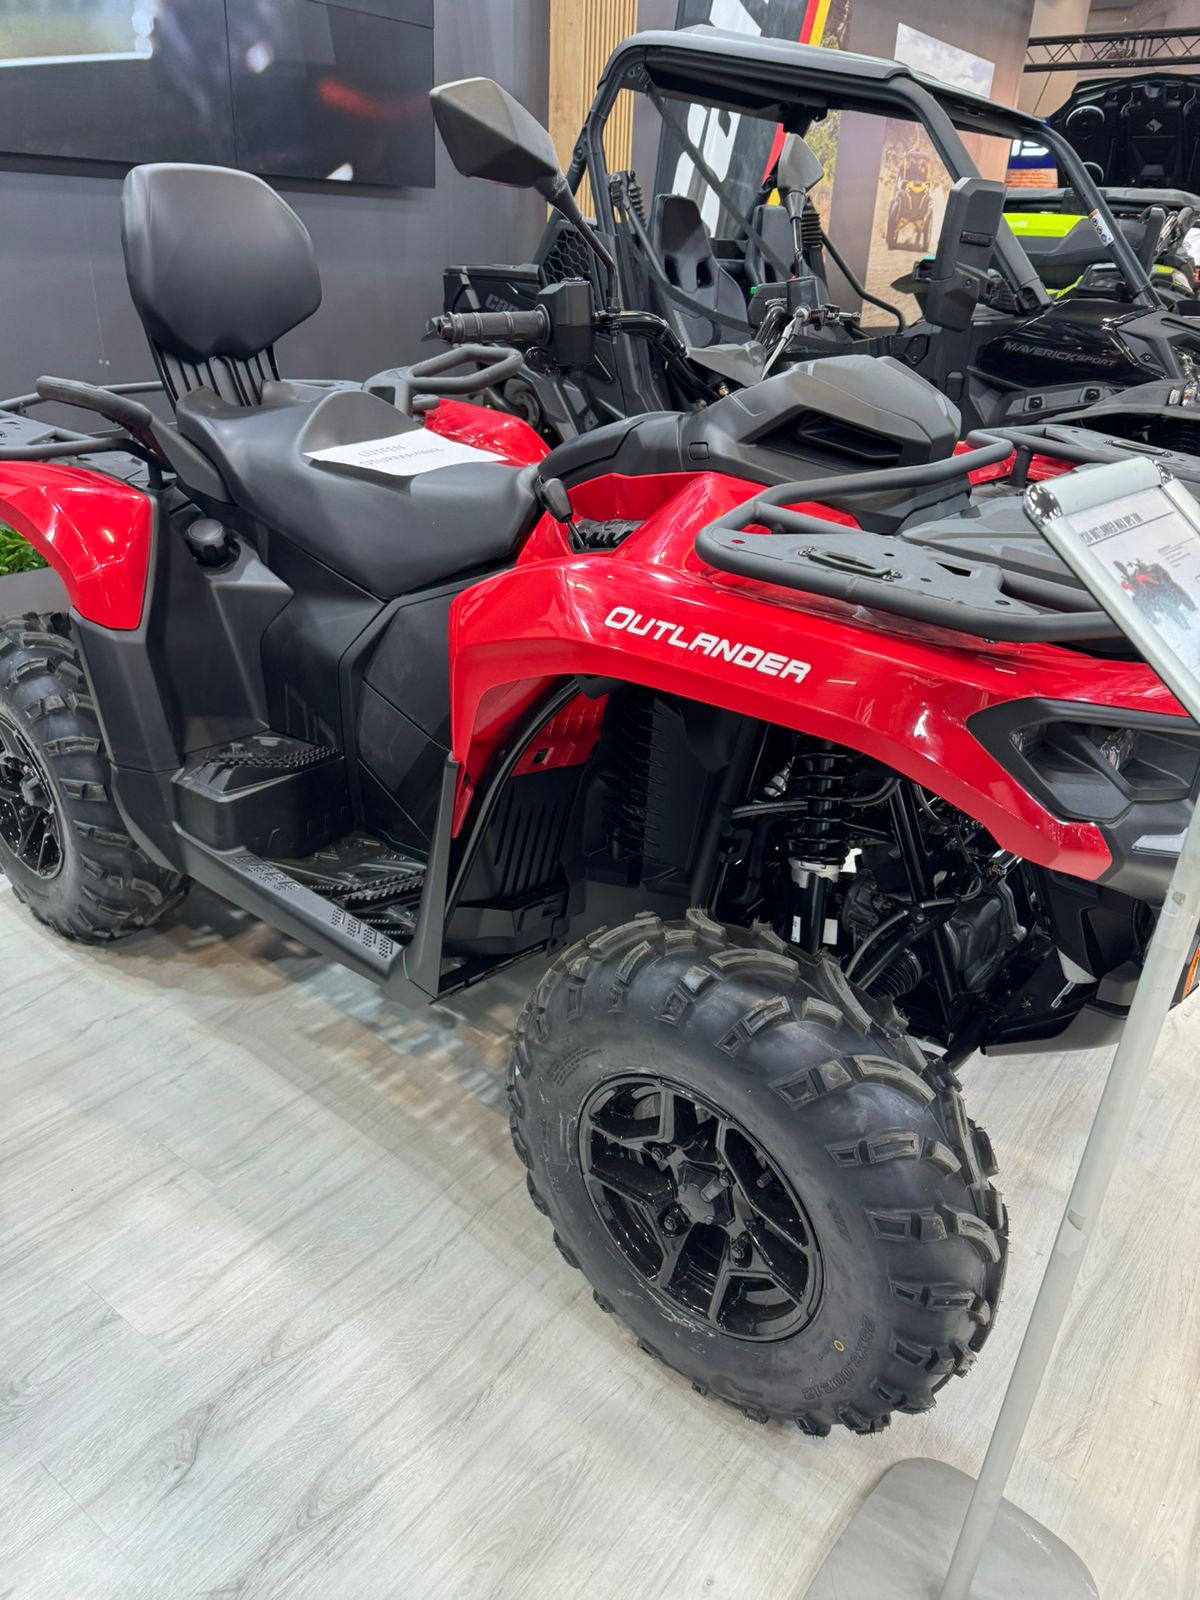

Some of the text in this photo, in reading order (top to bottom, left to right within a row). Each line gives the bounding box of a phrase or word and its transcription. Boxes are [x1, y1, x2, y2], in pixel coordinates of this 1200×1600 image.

[1003, 341, 1118, 367] MAVERICK SPORT
[604, 606, 812, 684] OUTLANDER
